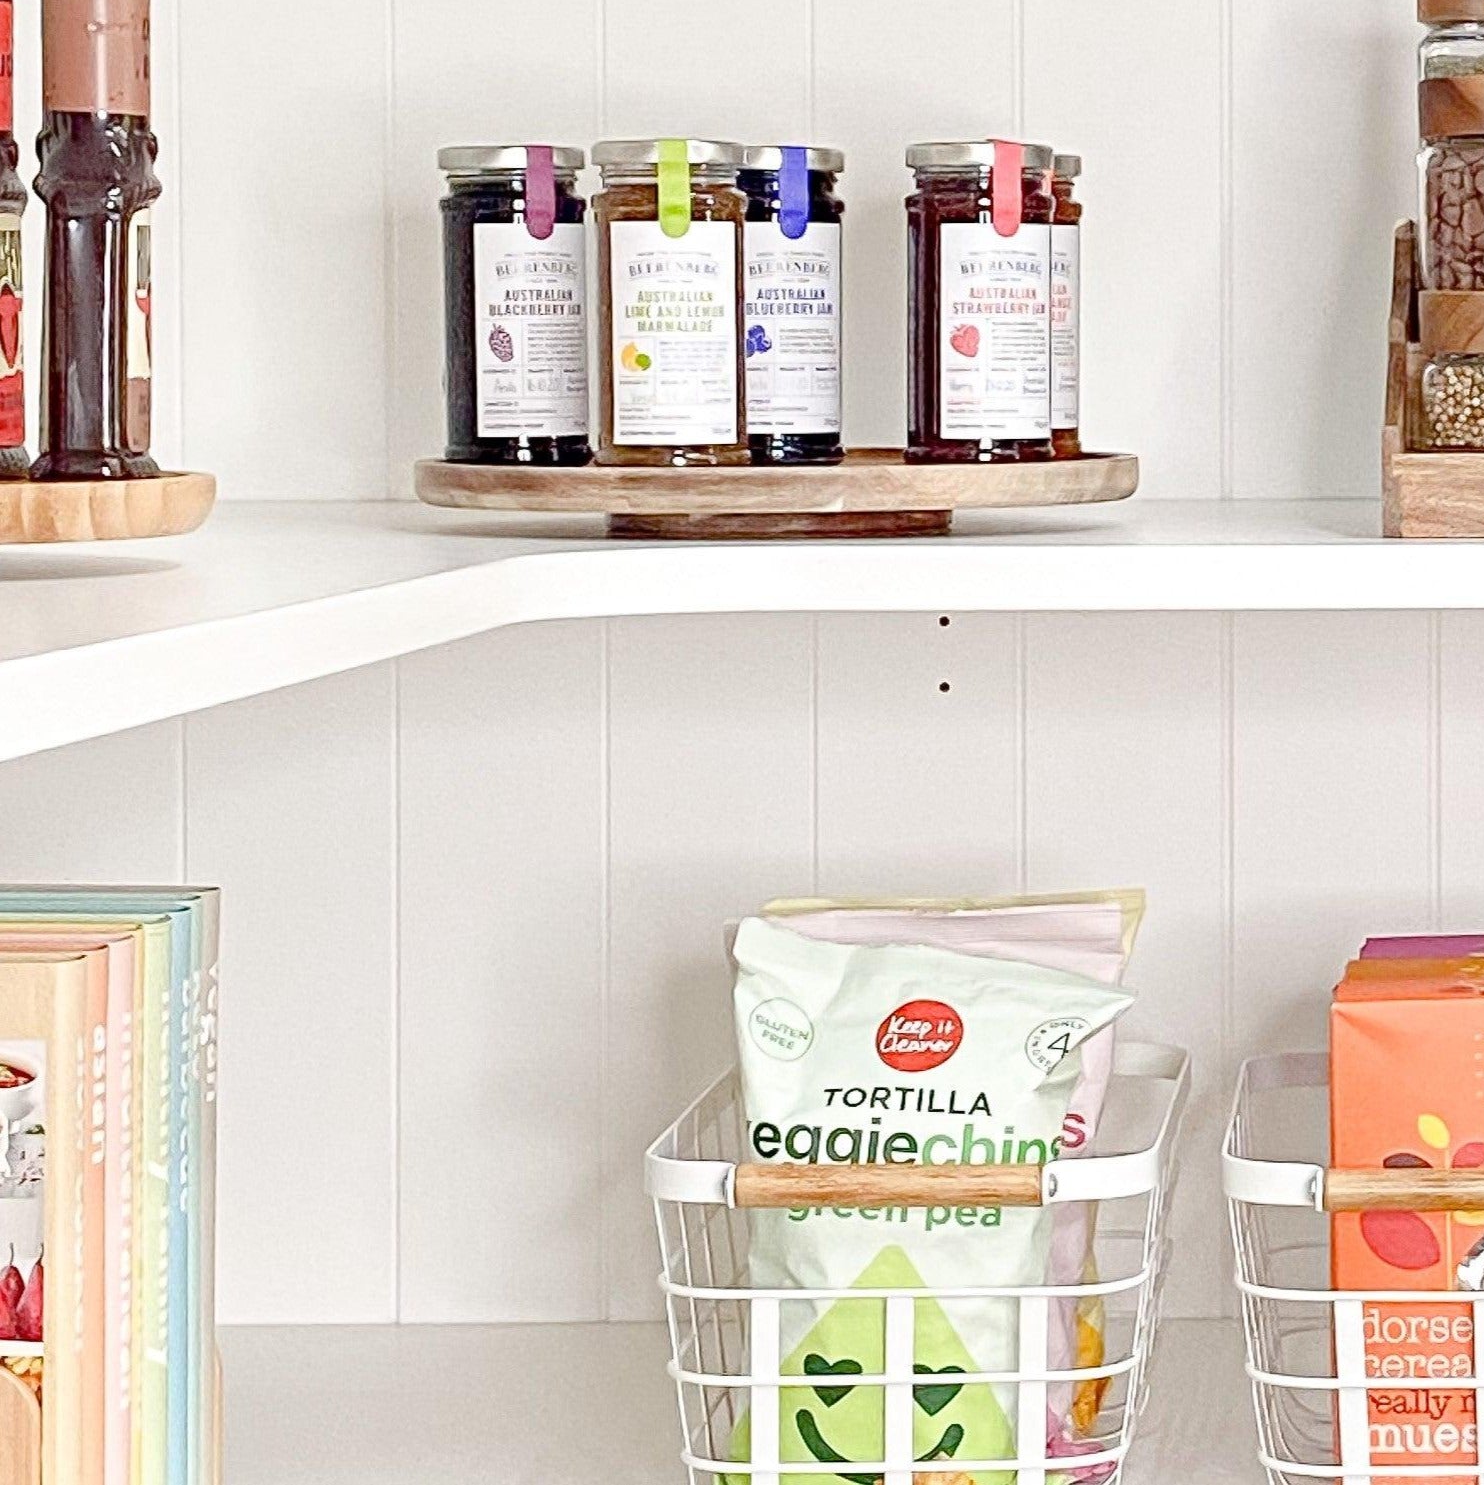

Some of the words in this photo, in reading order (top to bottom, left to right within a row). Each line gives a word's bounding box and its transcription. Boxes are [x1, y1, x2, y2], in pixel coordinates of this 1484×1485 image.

[503, 289, 573, 302] AUSTRALIAN
[637, 290, 714, 303] AUSTRALIAN
[756, 288, 825, 300] AUSTRALIAN
[969, 287, 1037, 300] AUSTRALIAN
[488, 304, 565, 316] BLACKBERRY
[657, 305, 682, 317] AND
[687, 305, 725, 317] LEMON
[746, 303, 813, 316] BLUEBERRY
[953, 302, 1030, 314] STRAWBERRY
[637, 319, 713, 332] MARMALADE
[755, 1014, 810, 1041] GLUTEN
[887, 1016, 933, 1038] Keep
[761, 1029, 795, 1051] FREE
[880, 1033, 954, 1053] Cleaner
[1047, 1032, 1070, 1059] 4
[823, 1086, 993, 1116] TORTILLA
[925, 1204, 1001, 1231] pea
[1363, 1307, 1473, 1344] dorse
